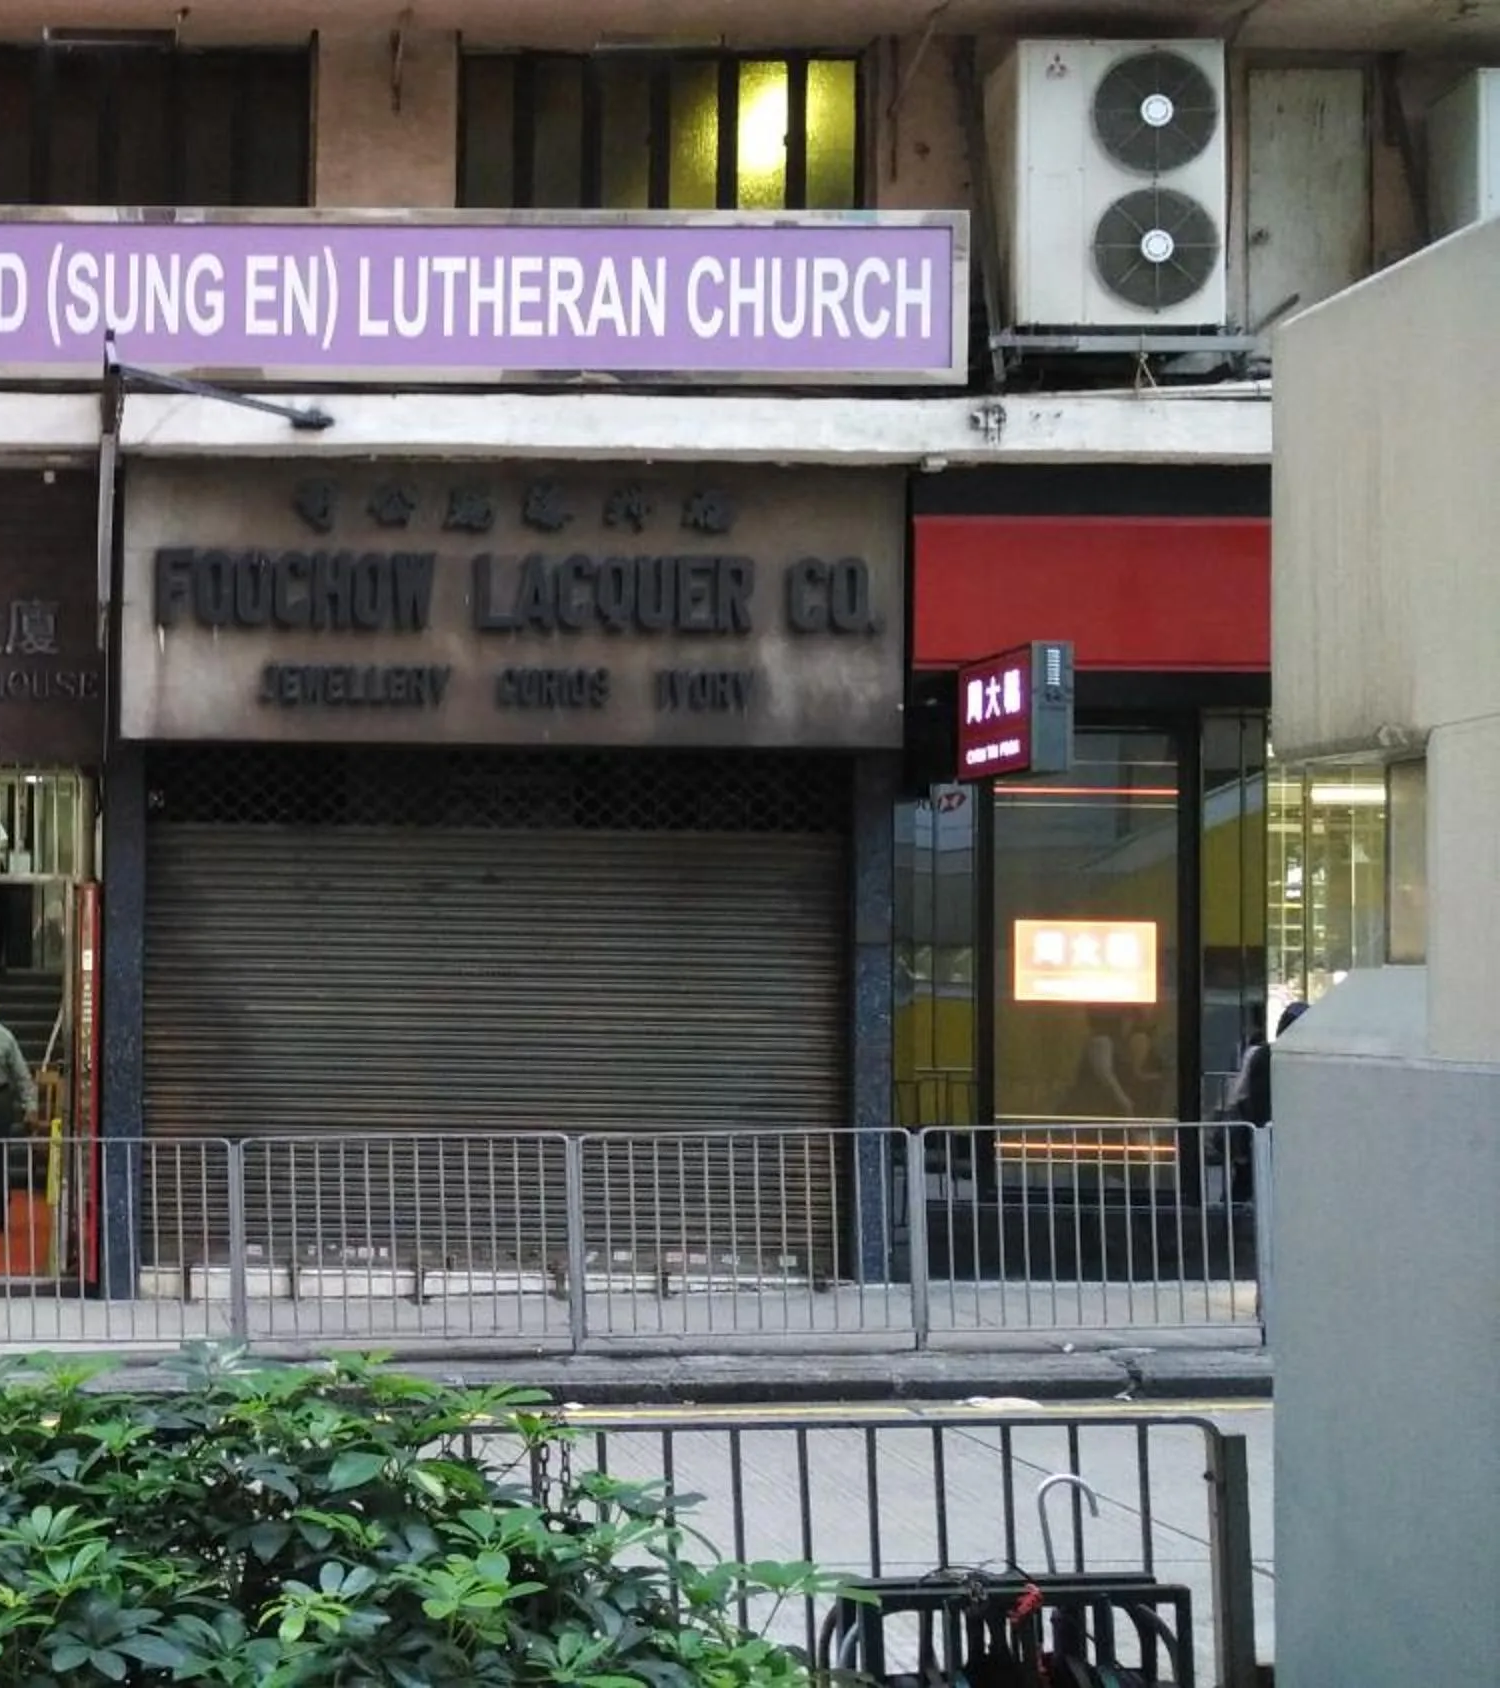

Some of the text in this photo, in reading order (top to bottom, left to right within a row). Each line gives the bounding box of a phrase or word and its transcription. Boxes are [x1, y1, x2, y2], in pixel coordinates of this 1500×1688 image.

[47, 243, 225, 348] (SUNG
[245, 245, 339, 351] EN)
[358, 255, 667, 338] LUTHERAN
[686, 255, 932, 339] CHURCH
[155, 548, 884, 635] FOOCHOW LACQUER CO.
[258, 665, 451, 708] JEWELLERY
